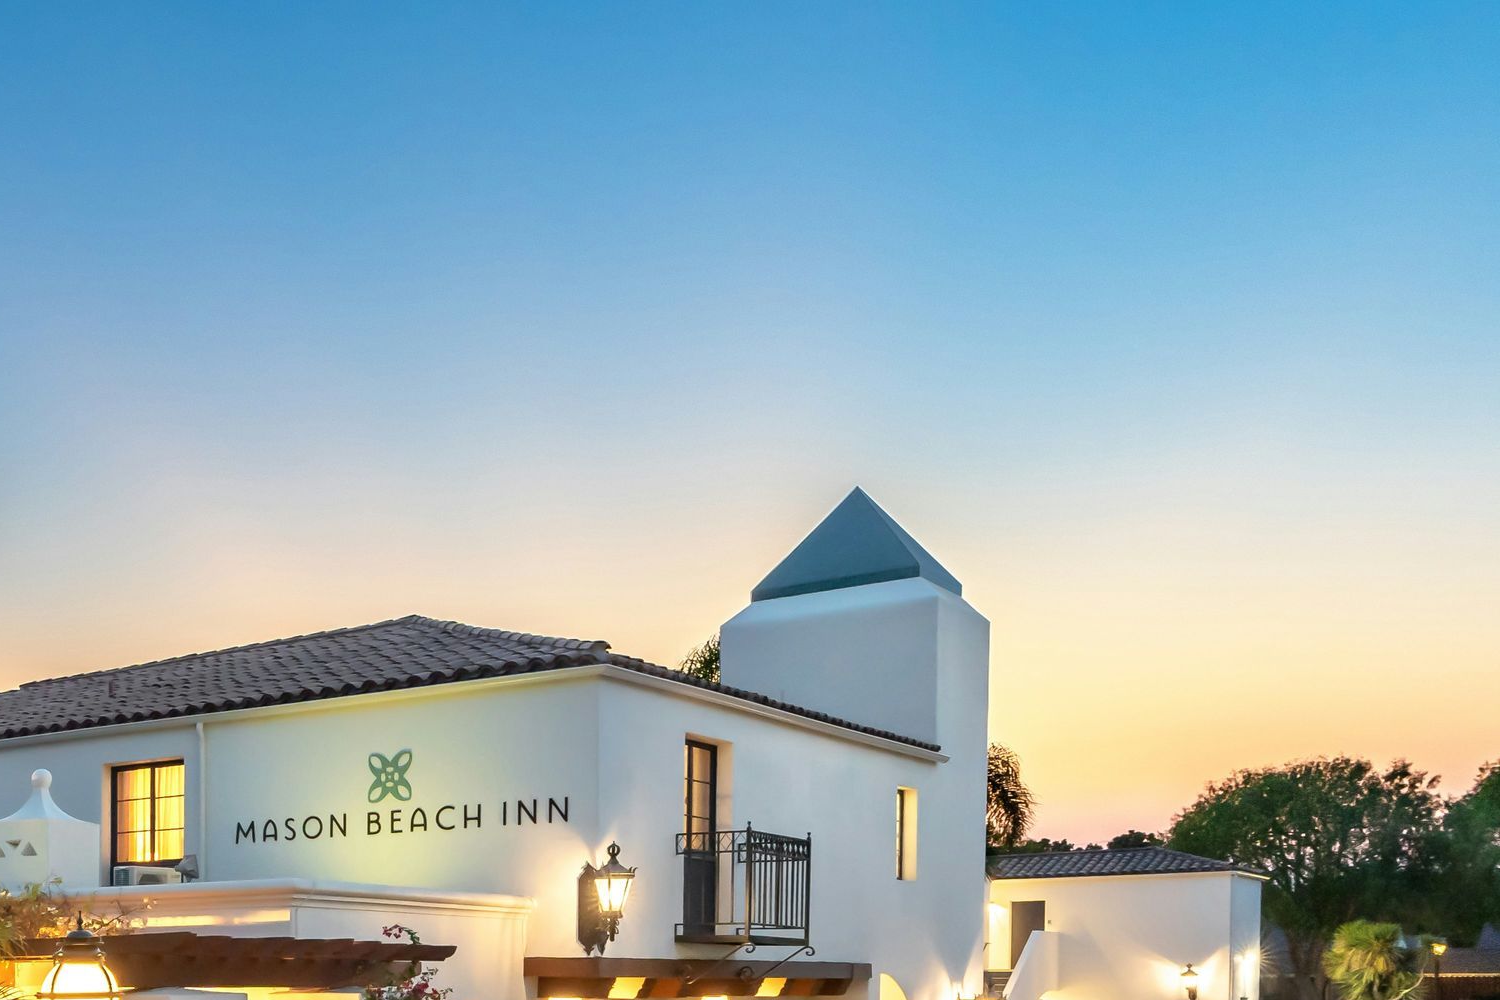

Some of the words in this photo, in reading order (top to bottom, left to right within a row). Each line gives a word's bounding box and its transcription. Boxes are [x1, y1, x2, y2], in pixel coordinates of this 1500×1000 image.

[235, 813, 348, 845] MASON
[367, 803, 482, 835] BEACH
[502, 796, 570, 826] INN
